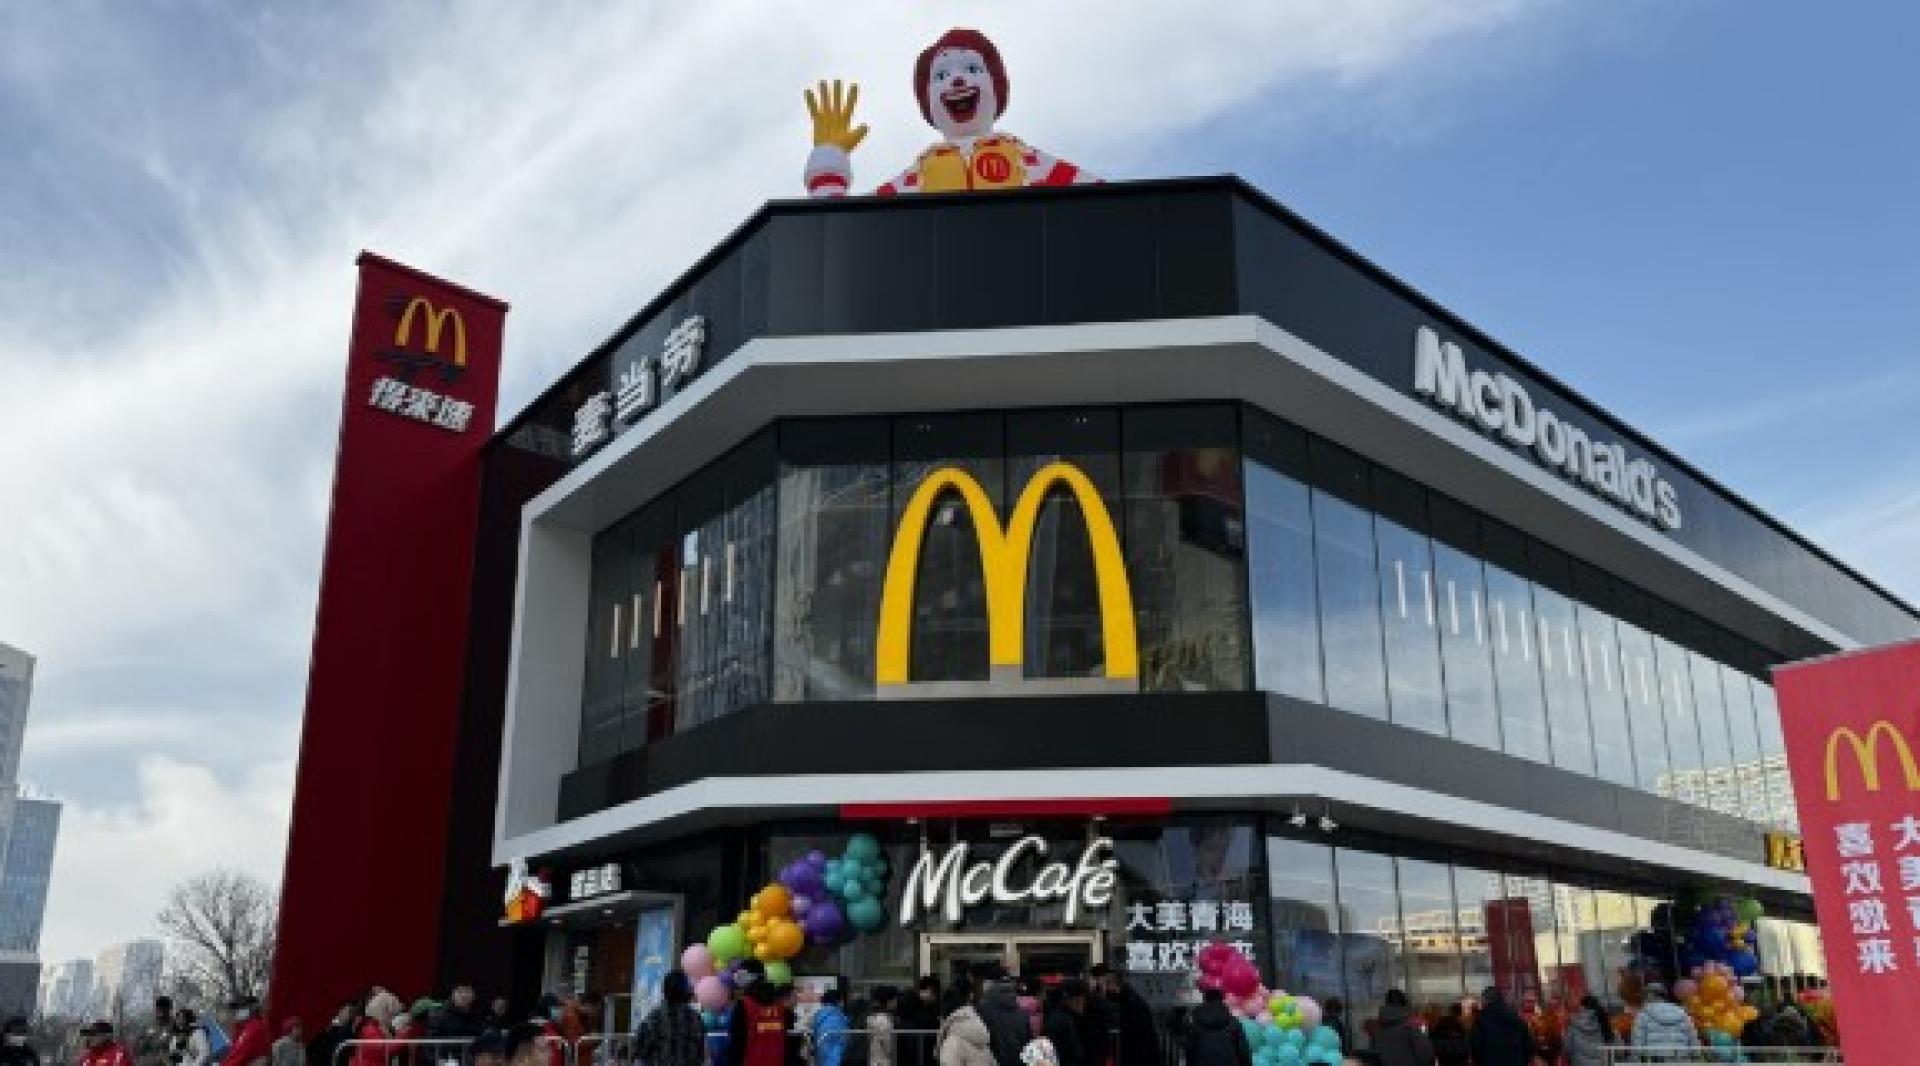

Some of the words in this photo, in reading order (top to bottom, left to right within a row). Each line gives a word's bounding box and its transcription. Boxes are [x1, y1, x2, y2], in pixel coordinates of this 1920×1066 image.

[572, 314, 705, 455] 麦当劳
[1415, 325, 1682, 529] McDonald's
[900, 836, 1119, 924] McCafé
[1126, 902, 1253, 931] 大美青海
[1890, 814, 1920, 966] 大美
[1126, 941, 1253, 971] 喜欢
